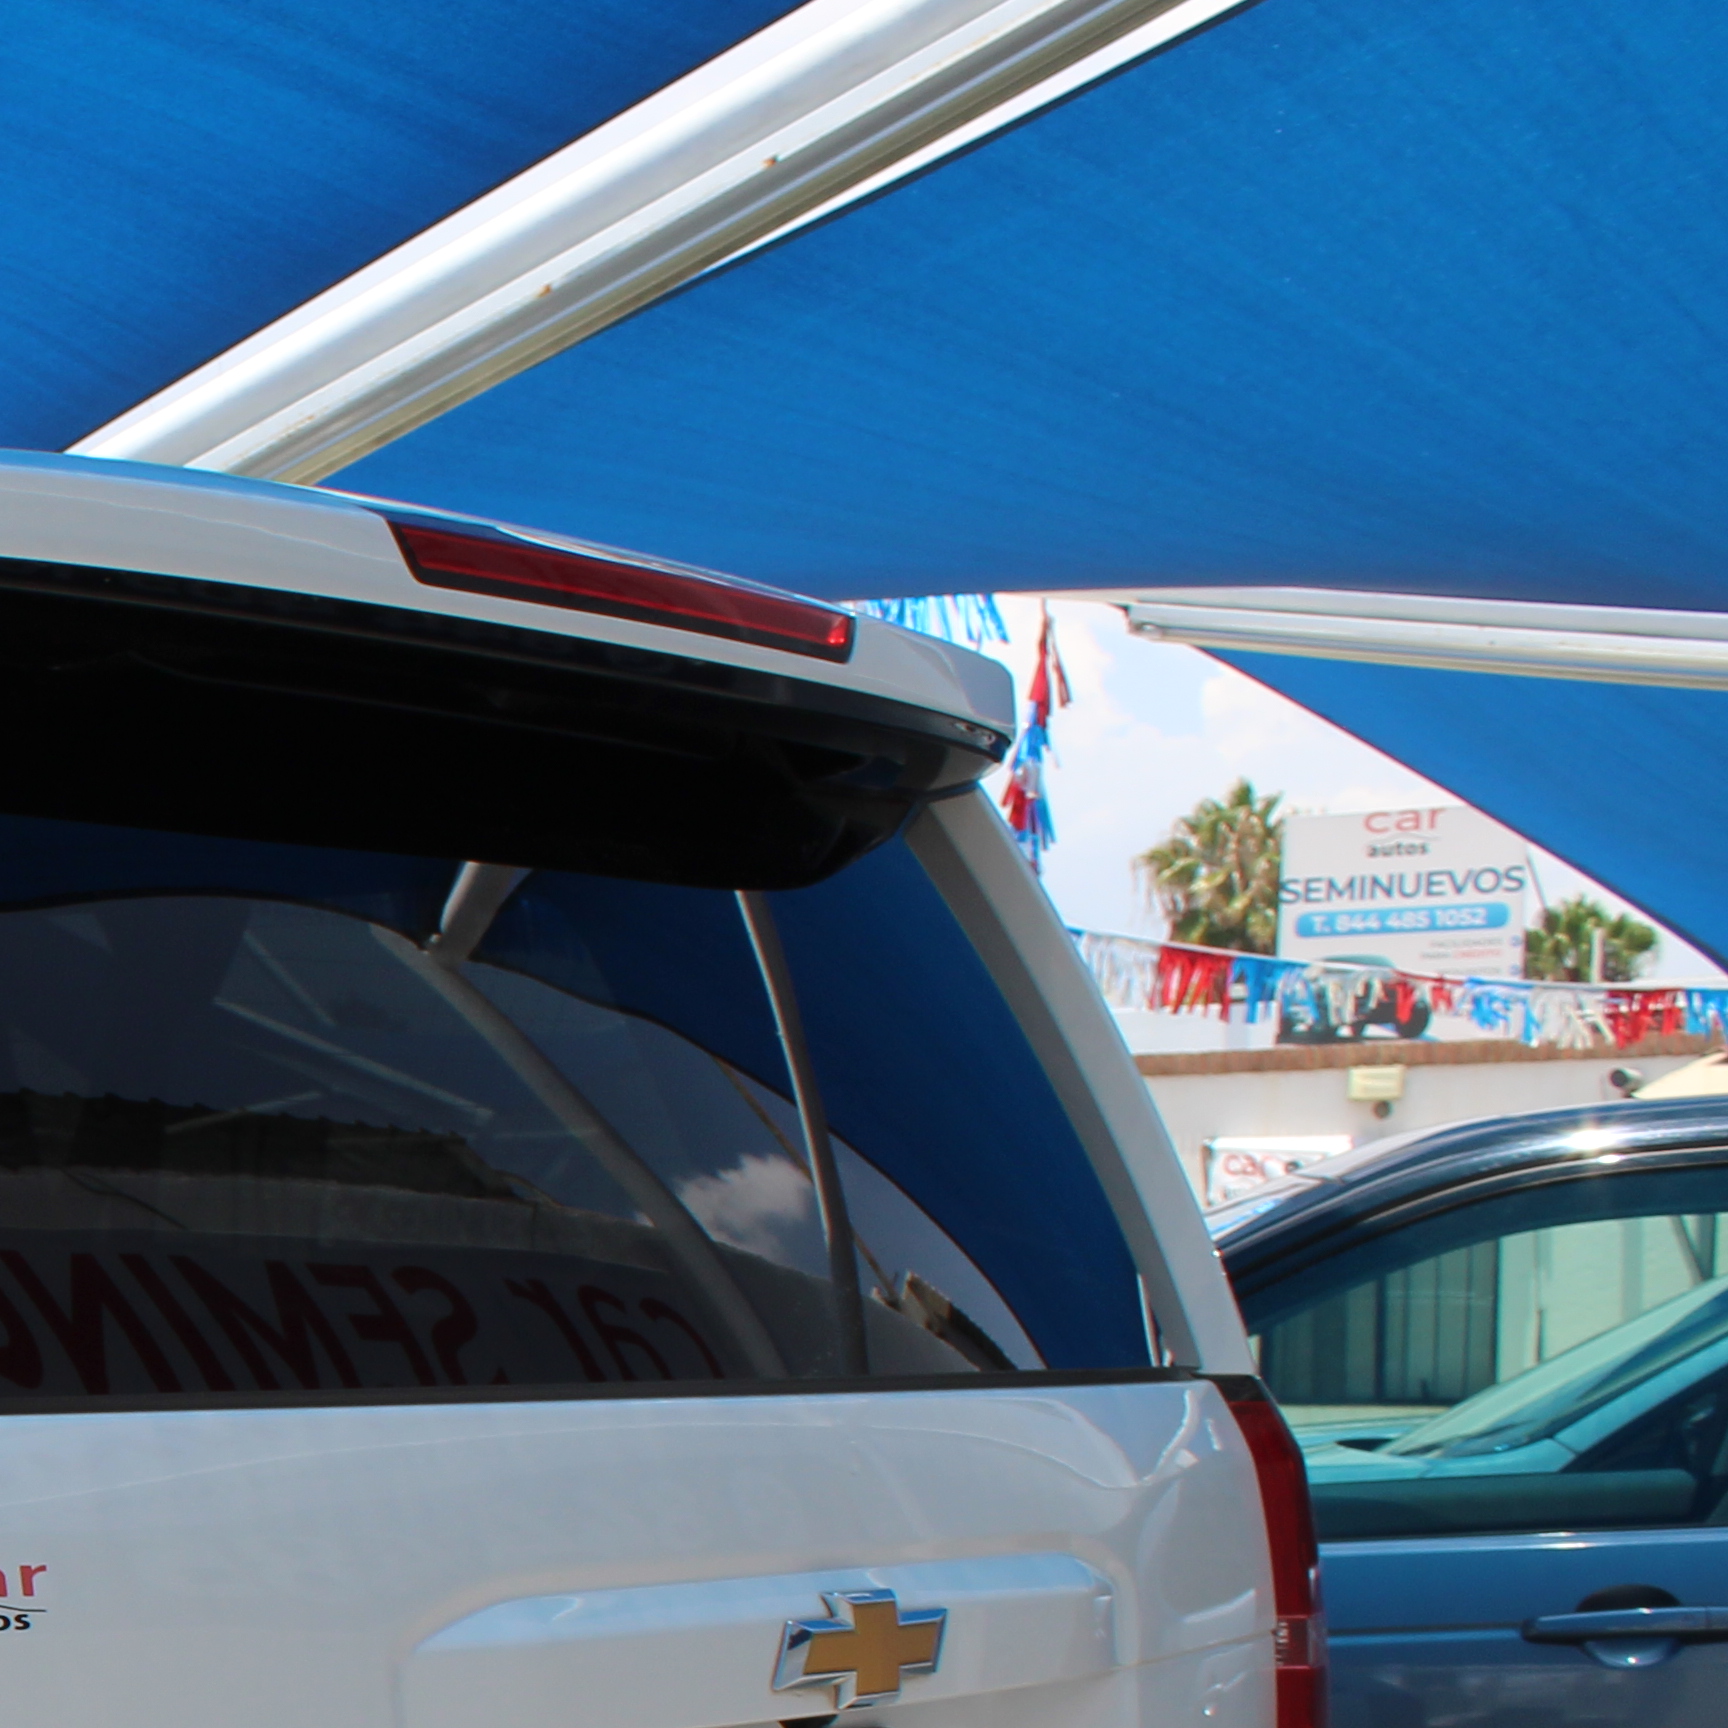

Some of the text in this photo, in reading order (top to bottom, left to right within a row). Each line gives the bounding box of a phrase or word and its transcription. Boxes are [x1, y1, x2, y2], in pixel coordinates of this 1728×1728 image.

[1363, 808, 1446, 833] car
[1367, 841, 1429, 857] autos
[1280, 865, 1526, 904] SEMINUEVOS
[1335, 913, 1381, 932] 844
